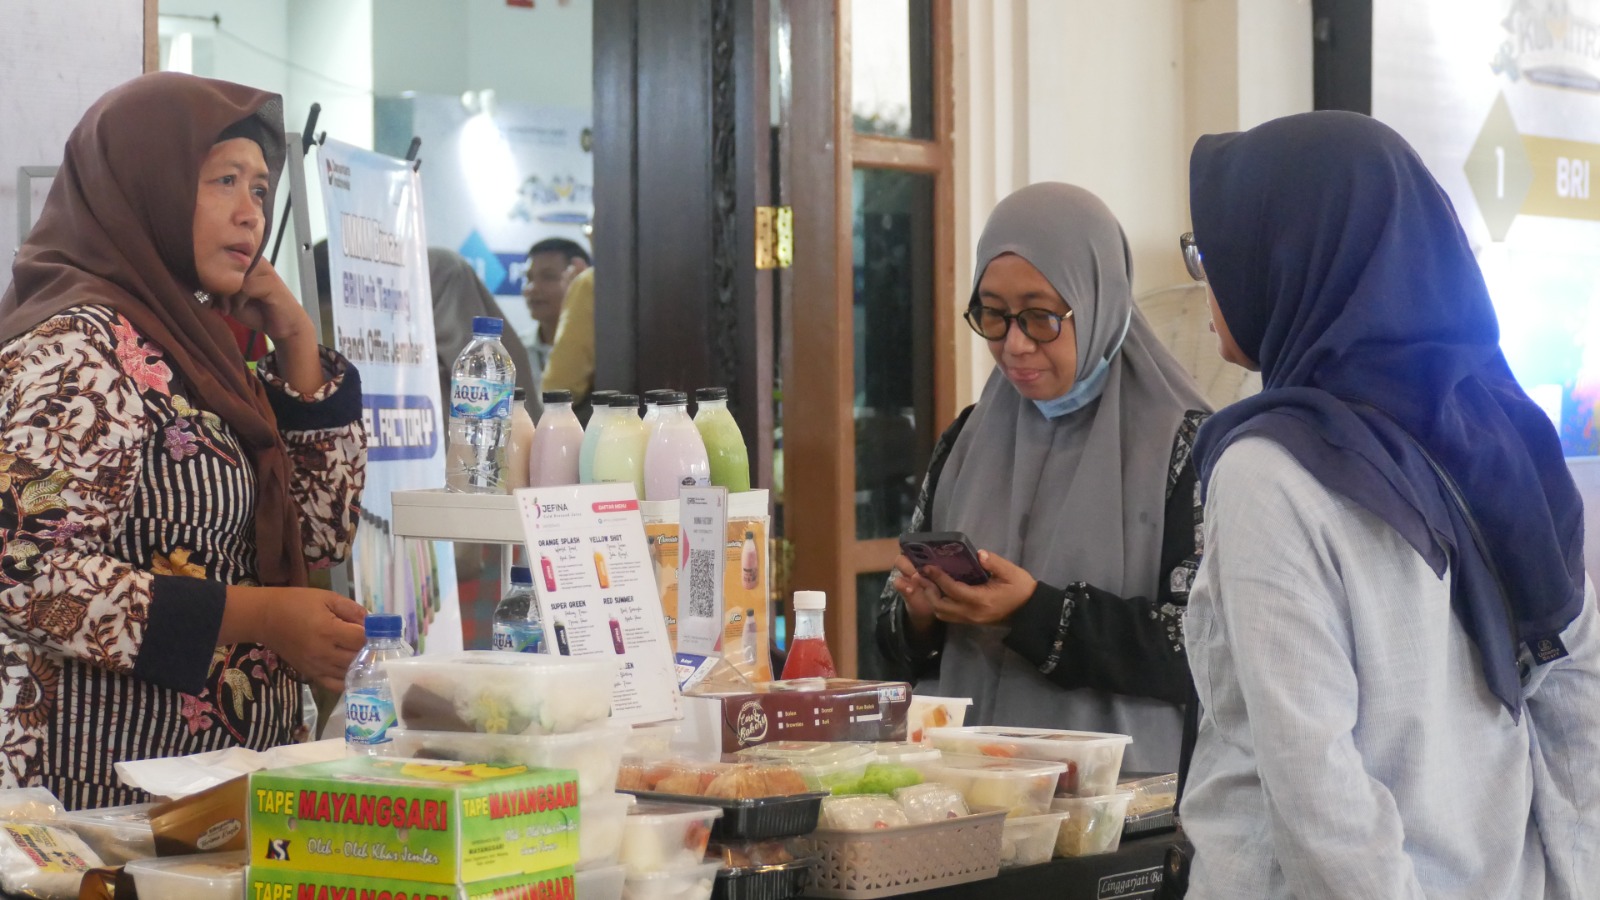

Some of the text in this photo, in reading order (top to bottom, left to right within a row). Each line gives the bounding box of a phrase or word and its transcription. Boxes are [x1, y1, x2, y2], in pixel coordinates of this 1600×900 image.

[1556, 157, 1590, 199] BRI
[454, 384, 489, 402] AQUA
[379, 409, 433, 446] FACTORY
[542, 503, 568, 512] JEFINA
[538, 537, 580, 547] ORANGE SPLASH
[589, 534, 622, 543] YELLOW SHOT
[550, 600, 586, 610] SUPER GREEN
[603, 596, 634, 605] RED SUMMER
[256, 789, 448, 831] TAPE MAYANGSARI
[463, 780, 578, 820] TAPE MAYANGSARI
[308, 838, 332, 855] Oleh
[344, 840, 368, 857] Oleh
[372, 844, 398, 861] Khas
[401, 846, 440, 865] Jember
[1101, 871, 1163, 894] Linggarjati Ba
